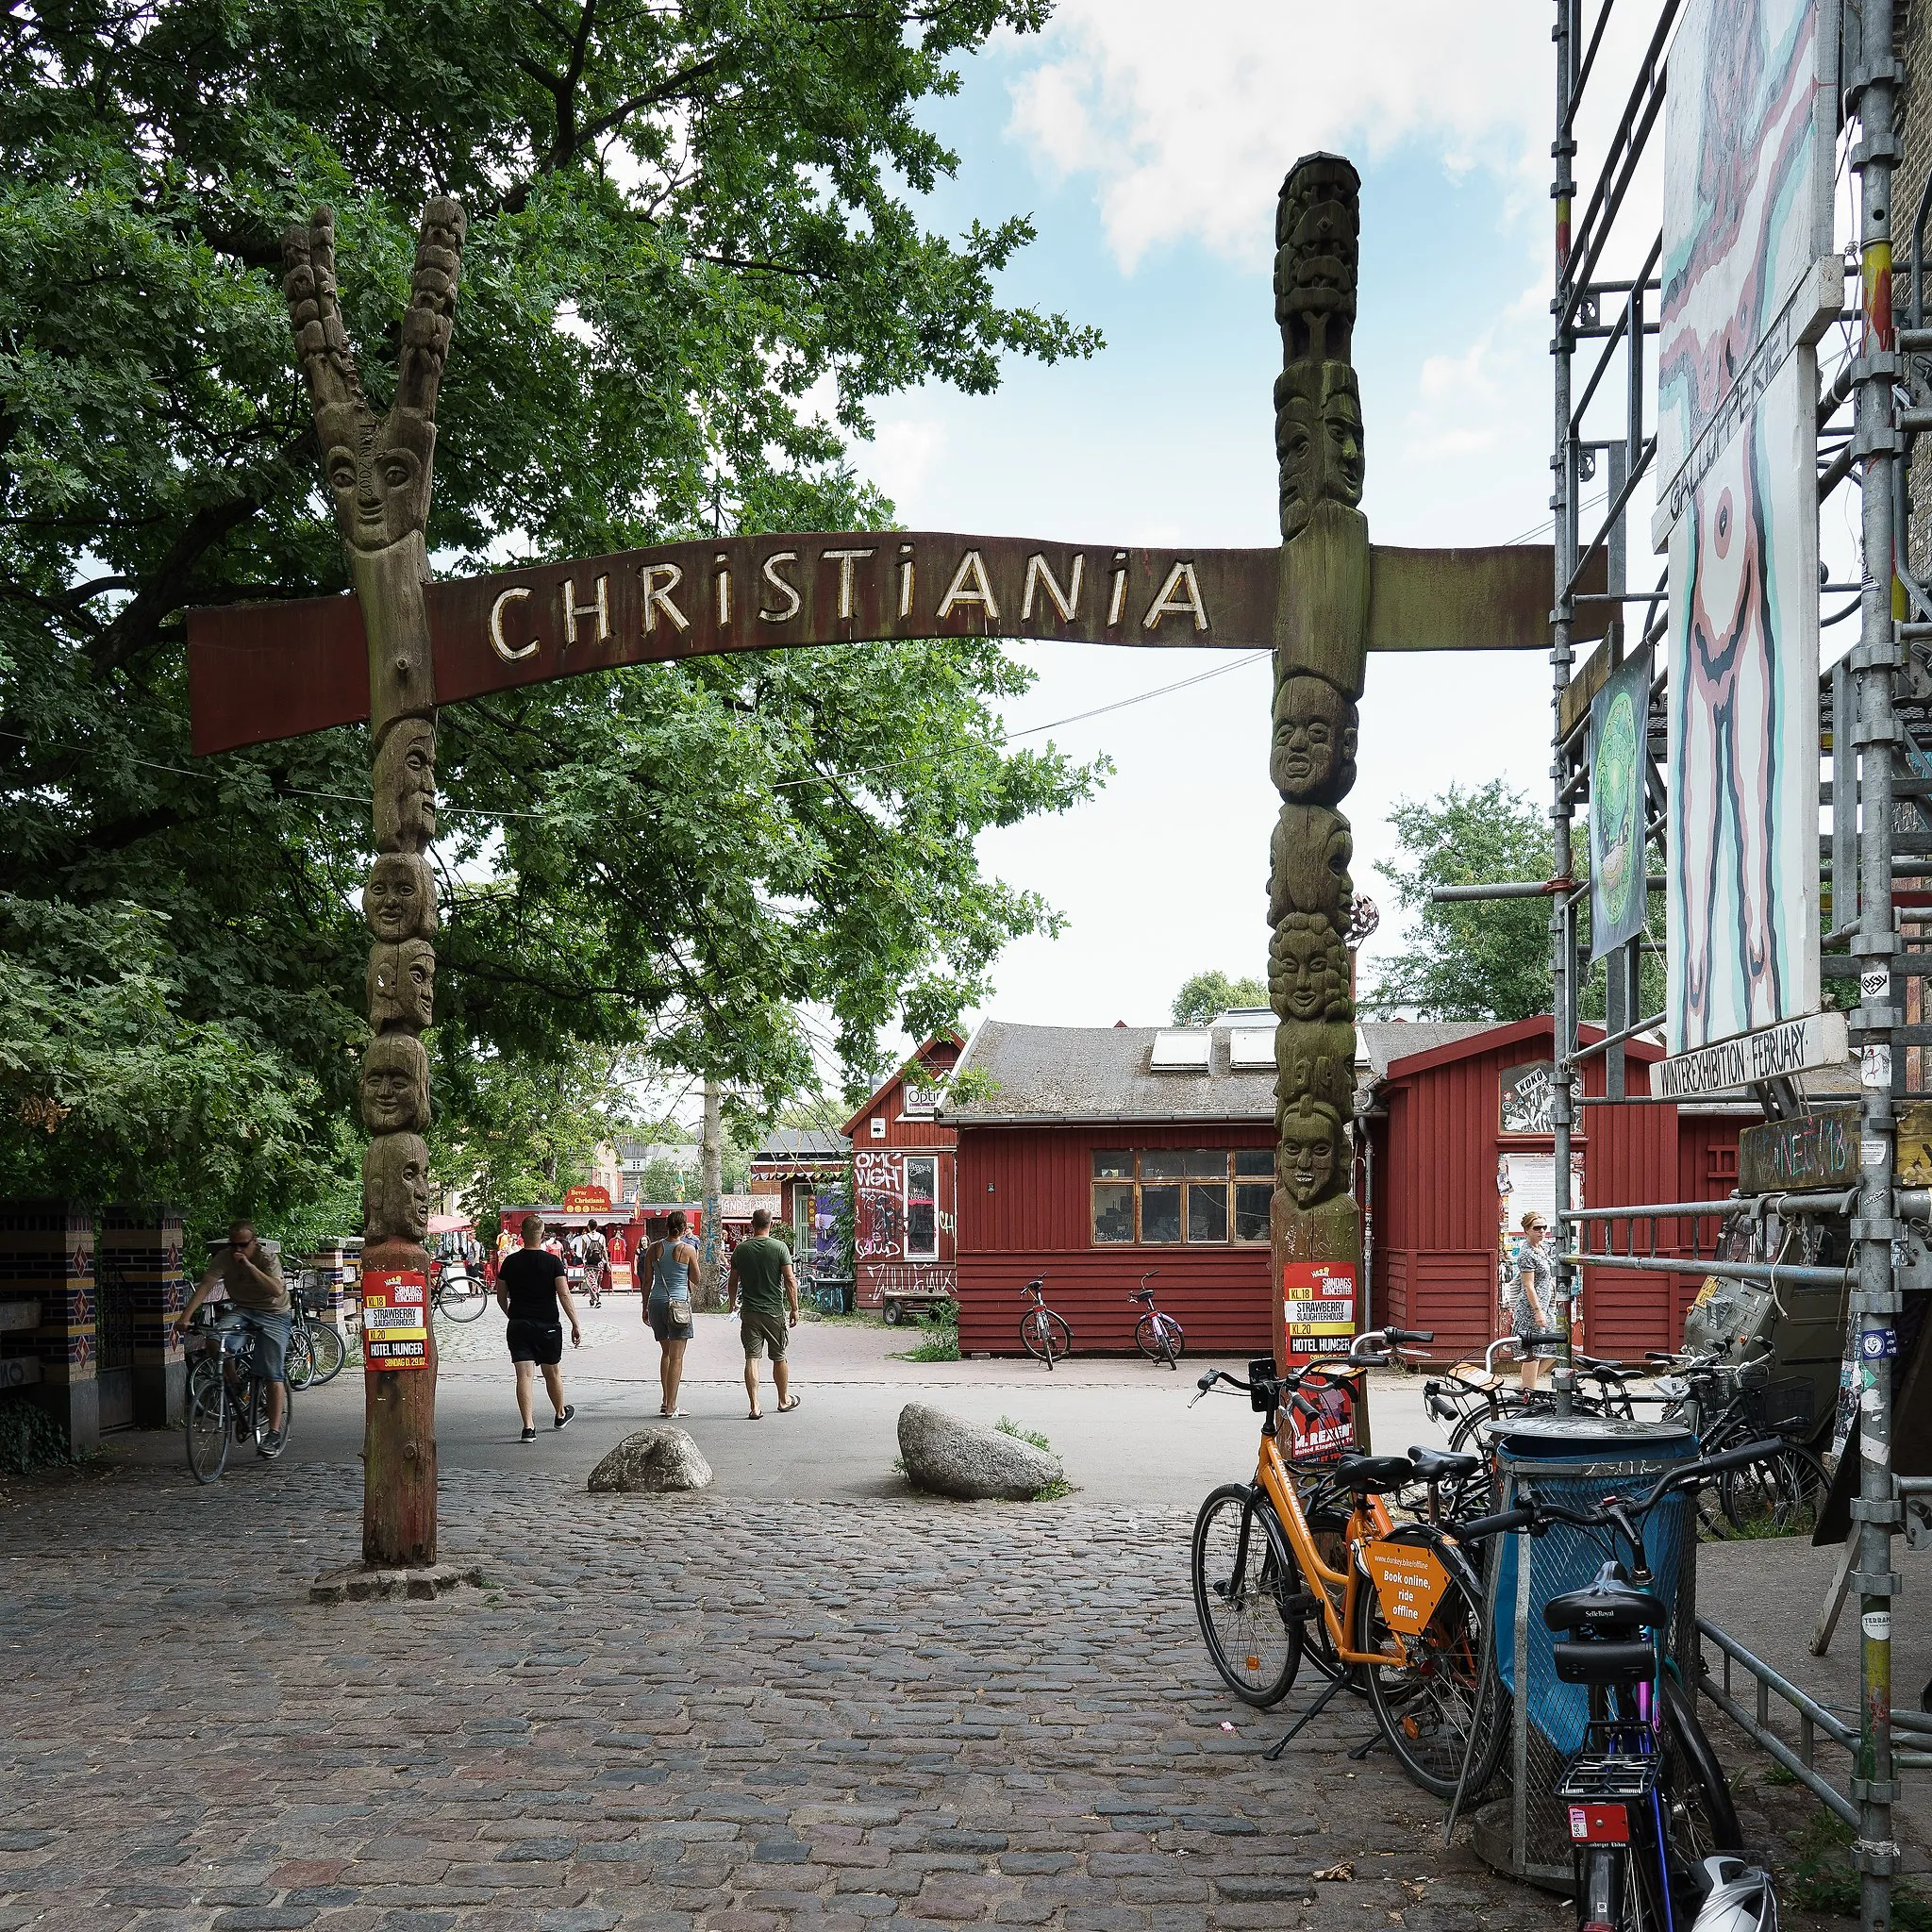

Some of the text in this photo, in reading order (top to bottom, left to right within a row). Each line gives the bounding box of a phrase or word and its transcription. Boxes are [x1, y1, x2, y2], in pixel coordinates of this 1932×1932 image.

[1519, 1070, 1543, 1092] KOKO
[1323, 1277, 1352, 1288] SØNDAGS
[394, 1286, 423, 1295] SØNDAGS
[1291, 1289, 1310, 1299] KL.18
[1323, 1287, 1352, 1295] KONCERTER
[368, 1296, 383, 1307] KL.18
[1297, 1302, 1344, 1312] STRAWBERRY
[373, 1308, 416, 1319] STRAWBERRY
[1297, 1312, 1344, 1321] SLAUGHTERHOUSE
[373, 1318, 416, 1326] SLAUGHTERHOUSE
[1292, 1324, 1311, 1334] KL.20
[370, 1330, 386, 1340] KL.20
[371, 1342, 423, 1356] HOTEL HUNGER
[1292, 1338, 1350, 1352] HOTEL HUNGER
[385, 1358, 405, 1367] SØNDAG
[1295, 1447, 1314, 1456] United
[1277, 1458, 1310, 1537] DONKEY REPUBLIC
[1374, 1555, 1429, 1571] www.donkey.bike/offline
[1384, 1570, 1431, 1590] Book online,
[1398, 1589, 1413, 1602] ride
[1392, 1605, 1418, 1620] offline
[1573, 1824, 1581, 1837] 568
